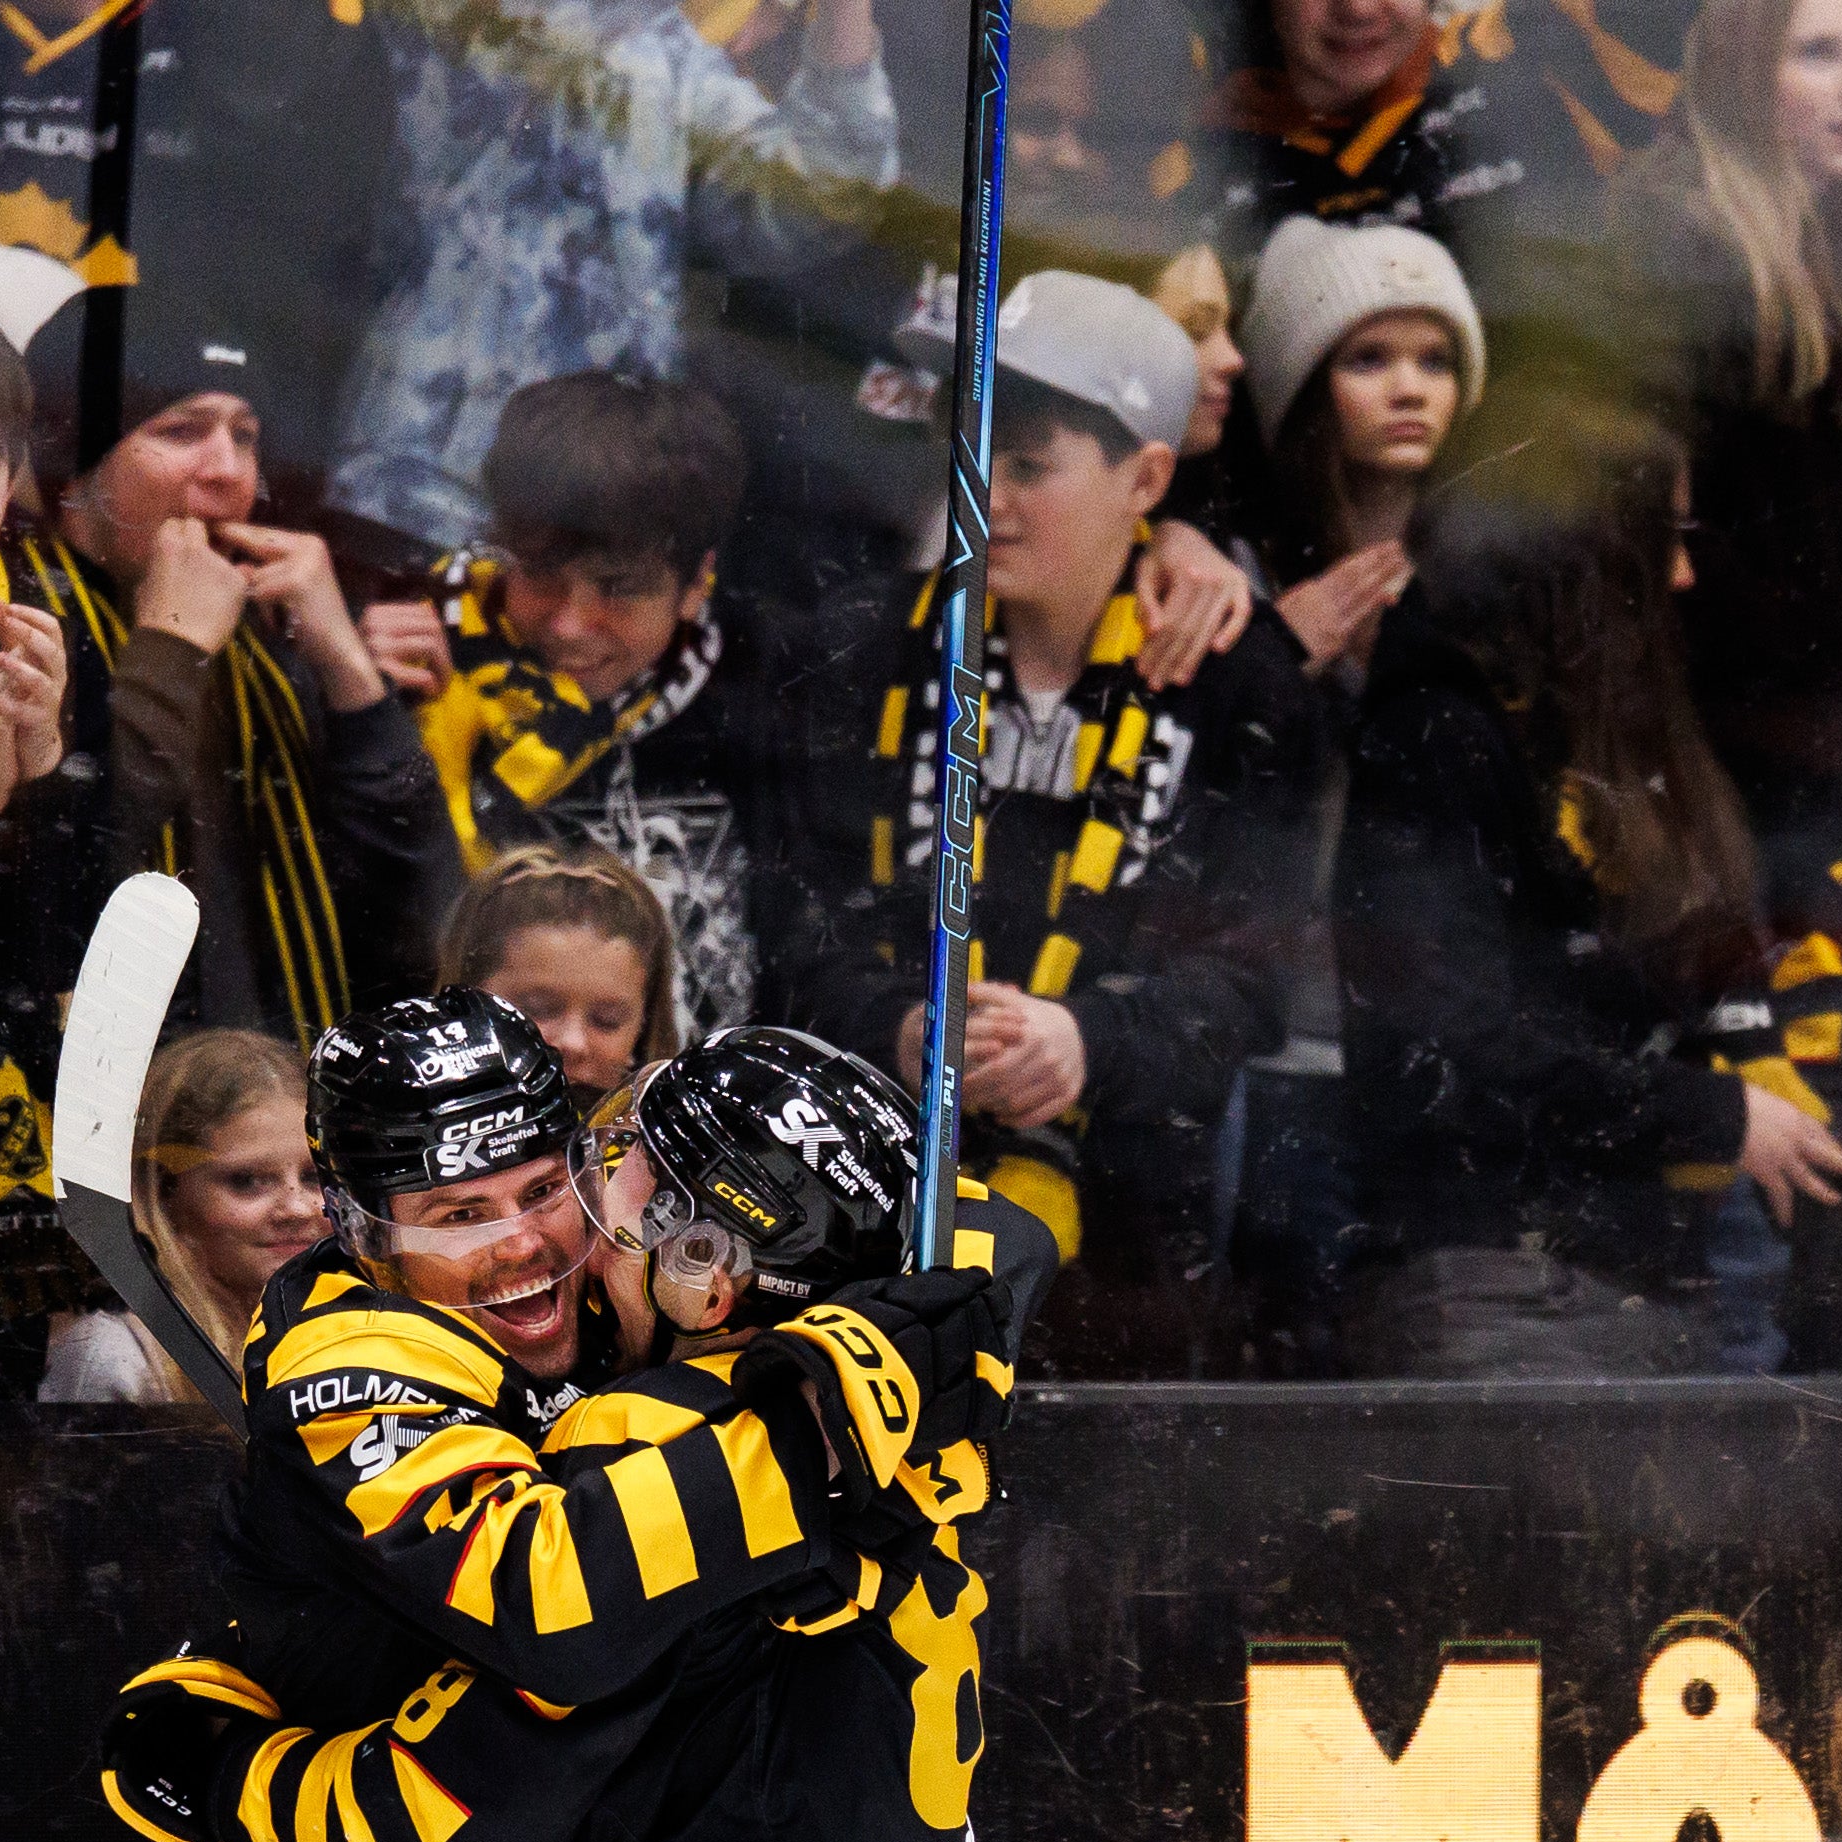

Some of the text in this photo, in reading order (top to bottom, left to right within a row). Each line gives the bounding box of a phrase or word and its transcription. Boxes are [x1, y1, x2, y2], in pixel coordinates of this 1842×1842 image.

[941, 664, 982, 940] CCM
[426, 1021, 468, 1047] 14
[442, 1105, 525, 1143] CCM
[487, 1125, 540, 1149] Skellefteå
[489, 1144, 518, 1160] Kraft
[824, 1158, 860, 1198] Kraft
[835, 1148, 895, 1215] Skellefteå
[714, 1181, 778, 1230] CCM
[758, 1272, 812, 1298] IMPACT BY
